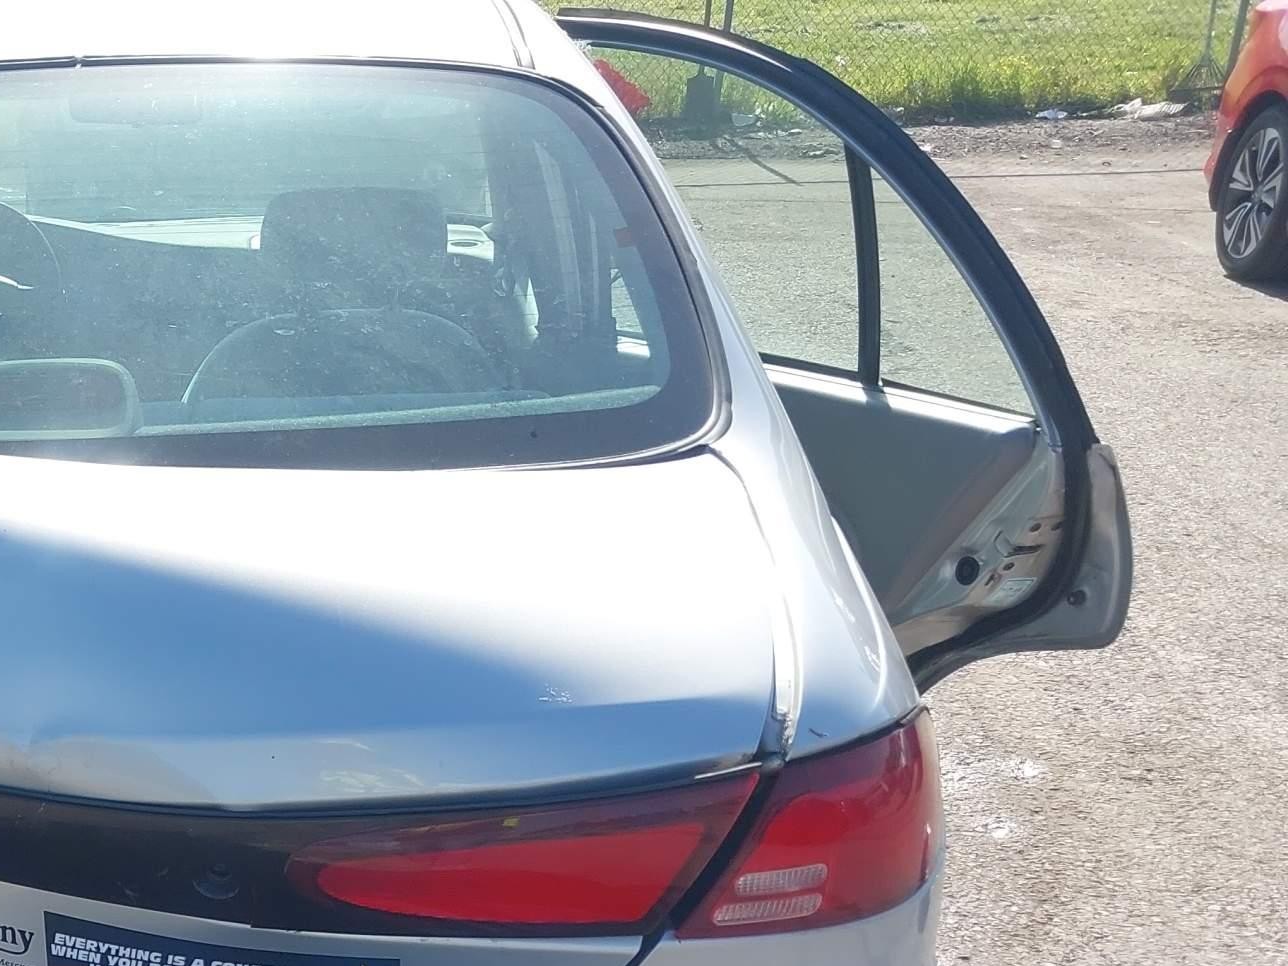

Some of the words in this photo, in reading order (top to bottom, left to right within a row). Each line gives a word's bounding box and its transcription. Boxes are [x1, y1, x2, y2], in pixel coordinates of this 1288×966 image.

[50, 943, 101, 963] WHEN
[54, 932, 162, 963] EVERYTHING
[167, 954, 187, 966] IS
